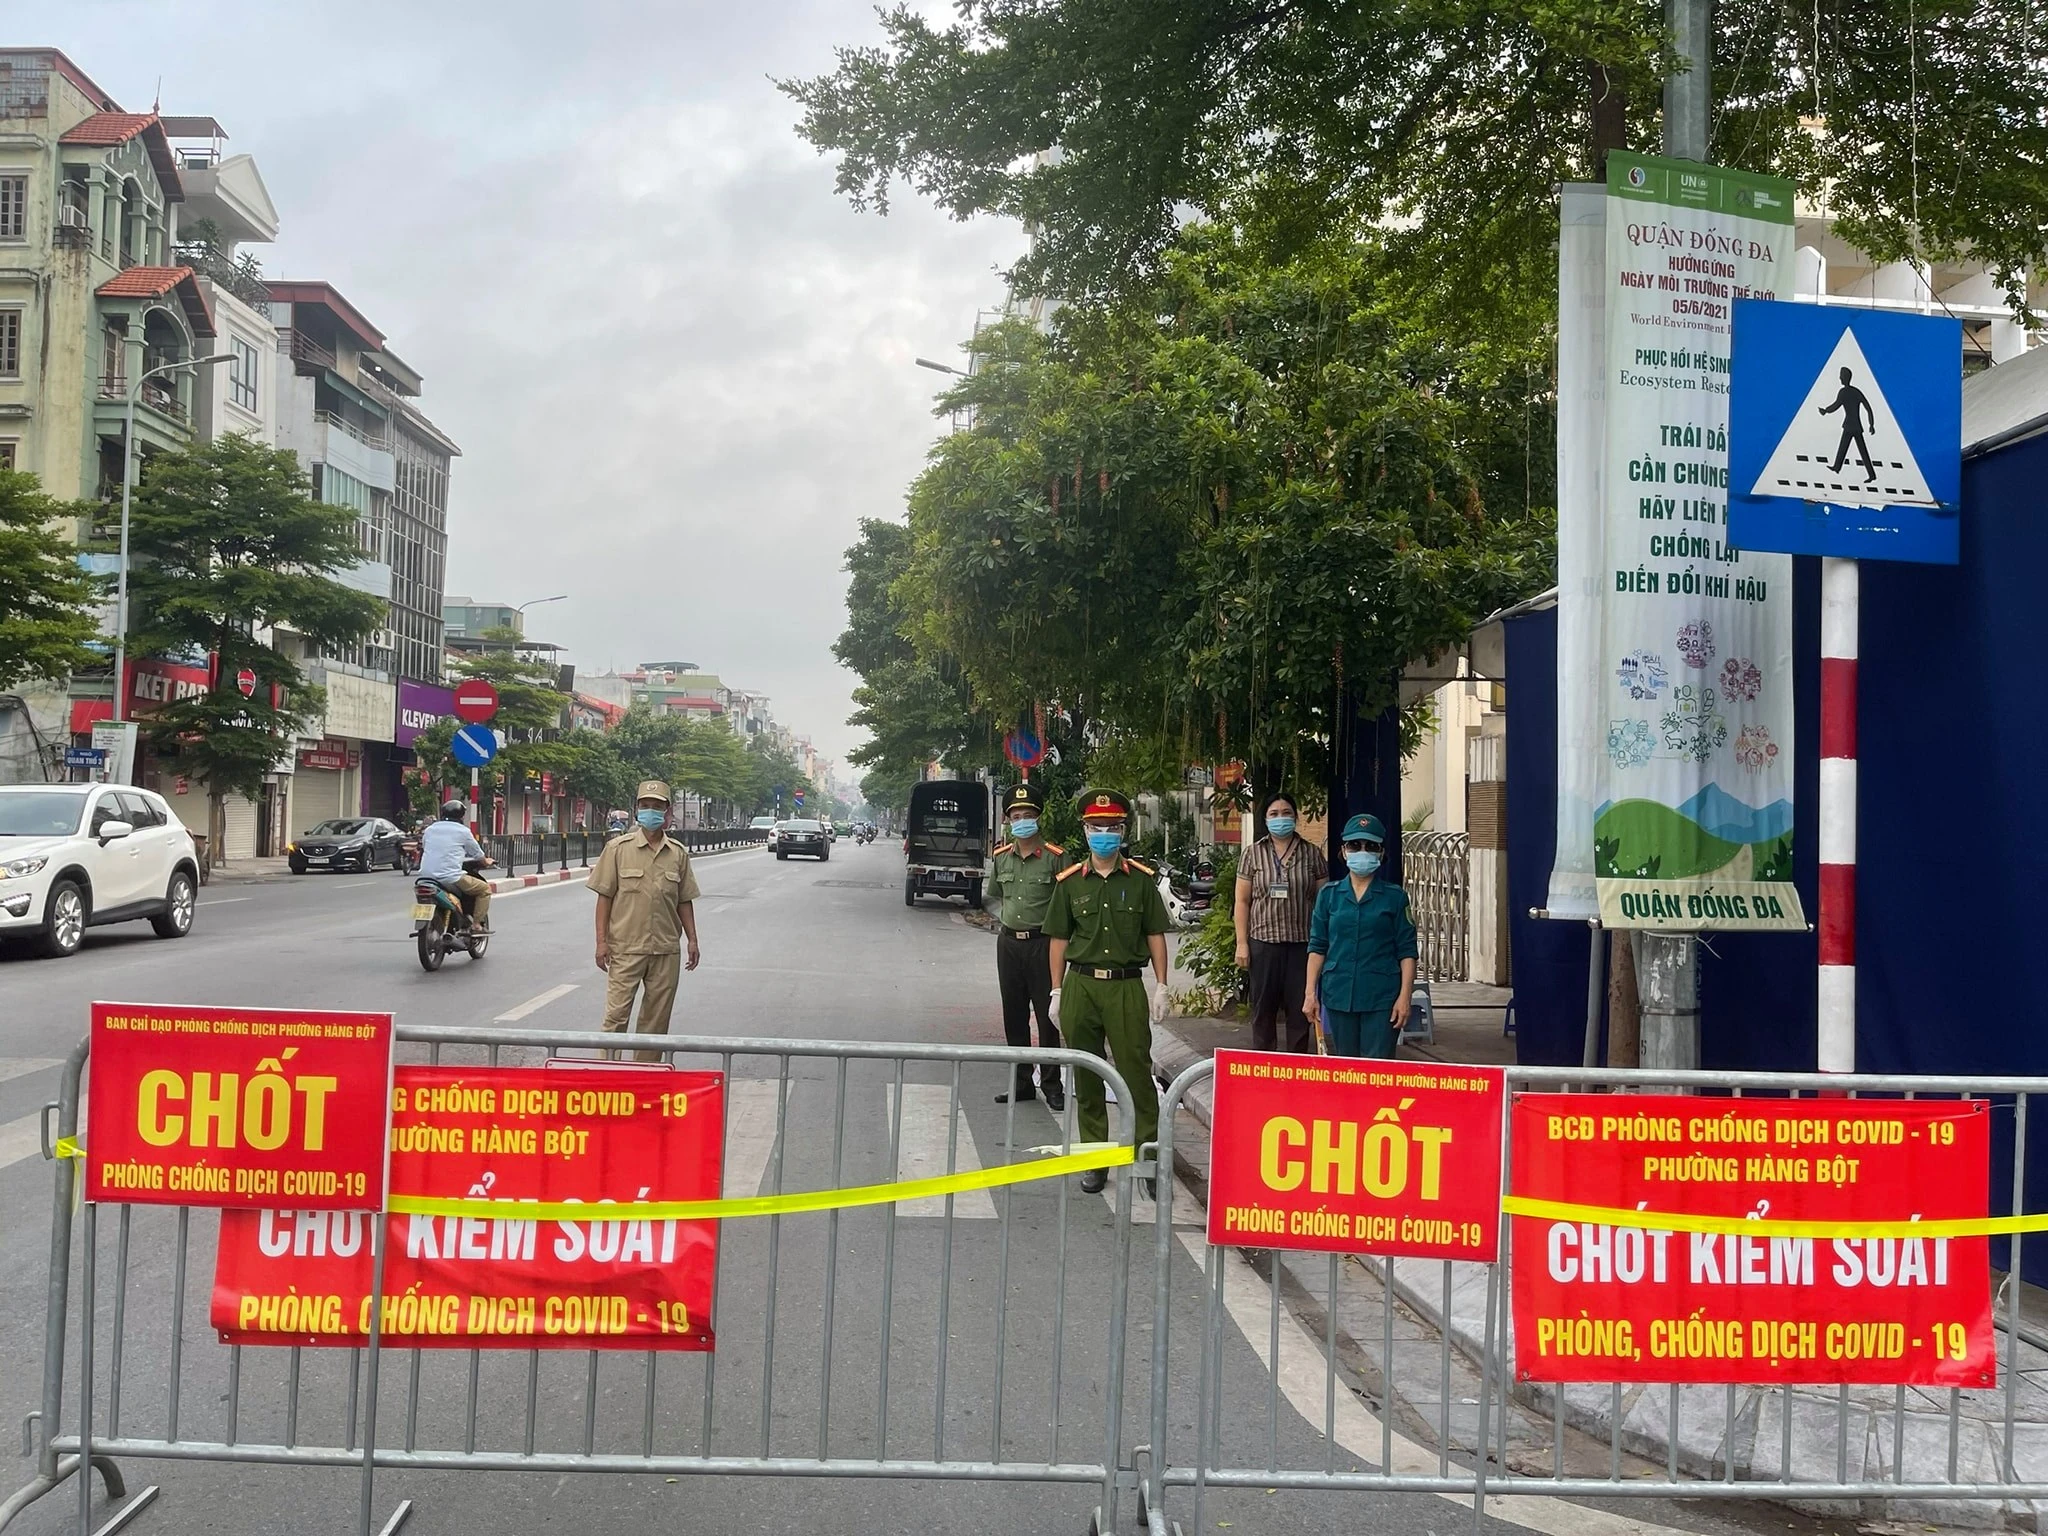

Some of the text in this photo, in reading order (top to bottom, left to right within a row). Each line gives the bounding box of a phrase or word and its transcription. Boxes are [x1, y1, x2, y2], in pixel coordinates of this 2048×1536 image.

[1681, 175, 1696, 187] UN
[1627, 222, 1774, 262] QUẬN ĐỐNG ĐA
[1620, 270, 1654, 289] NGÀY
[1684, 278, 1728, 298] TRƯỜNG
[1669, 253, 1735, 279] HƯỞNG ỨNG
[1630, 313, 1661, 325] World
[1664, 316, 1724, 334] Environment
[1673, 299, 1727, 319] 05/6/2021
[1635, 349, 1667, 370] PHỤC
[1694, 350, 1707, 373] HỆ
[1620, 370, 1696, 390] Ecosystem
[1661, 422, 1729, 452] TRÁI ĐẤ
[1629, 453, 1728, 488] CẦN CHÚNG
[1640, 494, 1675, 520] HÃY
[1683, 497, 1715, 524] LIÊN
[1650, 528, 1710, 559] CHỐNG
[1616, 564, 1766, 605] BIẾN ĐỔI KHÍ HẬU
[1620, 887, 1785, 923] QUẬN ĐỐNG ĐA
[106, 1014, 376, 1041] BAN CHỈ ĐẠO PHÒNG CHỐNG DỊCH PHƯỜNG HÀNG BỘT
[1230, 1062, 1490, 1094] BAN CHỈ ĐẠO PHÒNG CHỐNG DỊCH PHƯỜNG HÀNG BỘT
[137, 1047, 337, 1151] CHỐT
[414, 1080, 496, 1113] CHỐNG
[503, 1089, 559, 1119] DỊCH
[566, 1091, 635, 1117] COVID
[660, 1093, 688, 1118] 19
[471, 1124, 537, 1154] HÀNG
[544, 1125, 589, 1161] BỘT
[1548, 1117, 1595, 1141] BCĐ
[1602, 1112, 1682, 1143] PHÒNG
[1689, 1110, 1768, 1144] CHỐNG
[1775, 1119, 1829, 1149] DỊCH
[1836, 1120, 1903, 1144] COVID
[1928, 1122, 1954, 1146] 19
[1260, 1098, 1452, 1200] CHỐT
[102, 1158, 366, 1199] PHÒNG CHỐNG DỊCH COVID-19
[1644, 1152, 1860, 1188] PHƯỜNG HÀNG BỘT
[407, 1172, 538, 1261] KIỂM
[554, 1187, 678, 1263] SOÁT
[1226, 1202, 1481, 1247] PHÒNG CHỐNG DỊCH COVID-19
[1548, 1200, 1955, 1288] CHỐT KIỂM SOÁT
[359, 1282, 464, 1335] CHỐNG
[544, 1296, 628, 1334] COVID
[657, 1300, 690, 1333] 19
[1537, 1311, 1641, 1363] PHÒNG,
[1650, 1306, 1743, 1359] CHỐNG
[1751, 1321, 1816, 1367] DỊCH
[1825, 1321, 1904, 1359] COVID
[1931, 1323, 1966, 1361] 19
